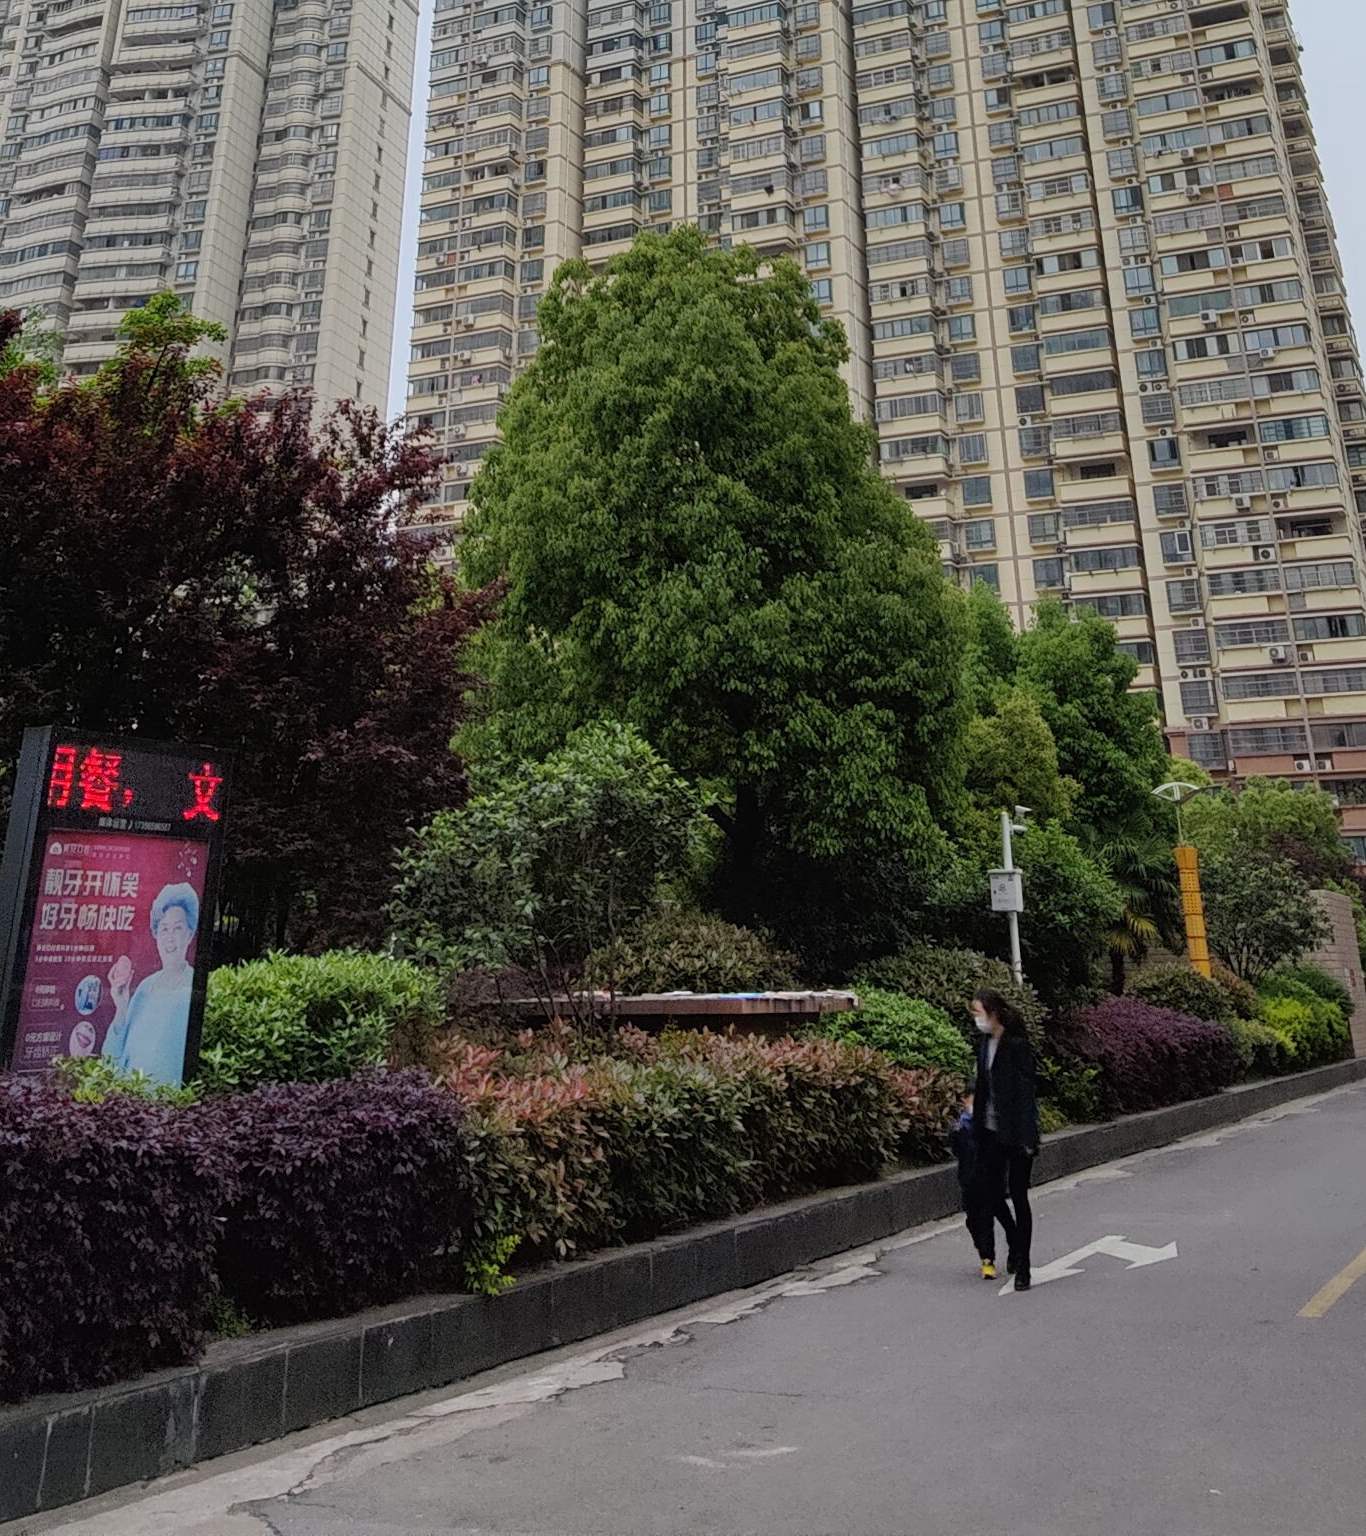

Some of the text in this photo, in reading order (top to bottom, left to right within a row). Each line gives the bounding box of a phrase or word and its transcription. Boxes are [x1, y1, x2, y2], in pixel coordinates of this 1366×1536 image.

[183, 762, 223, 821] 文
[39, 902, 136, 931] 好牙畅快吃
